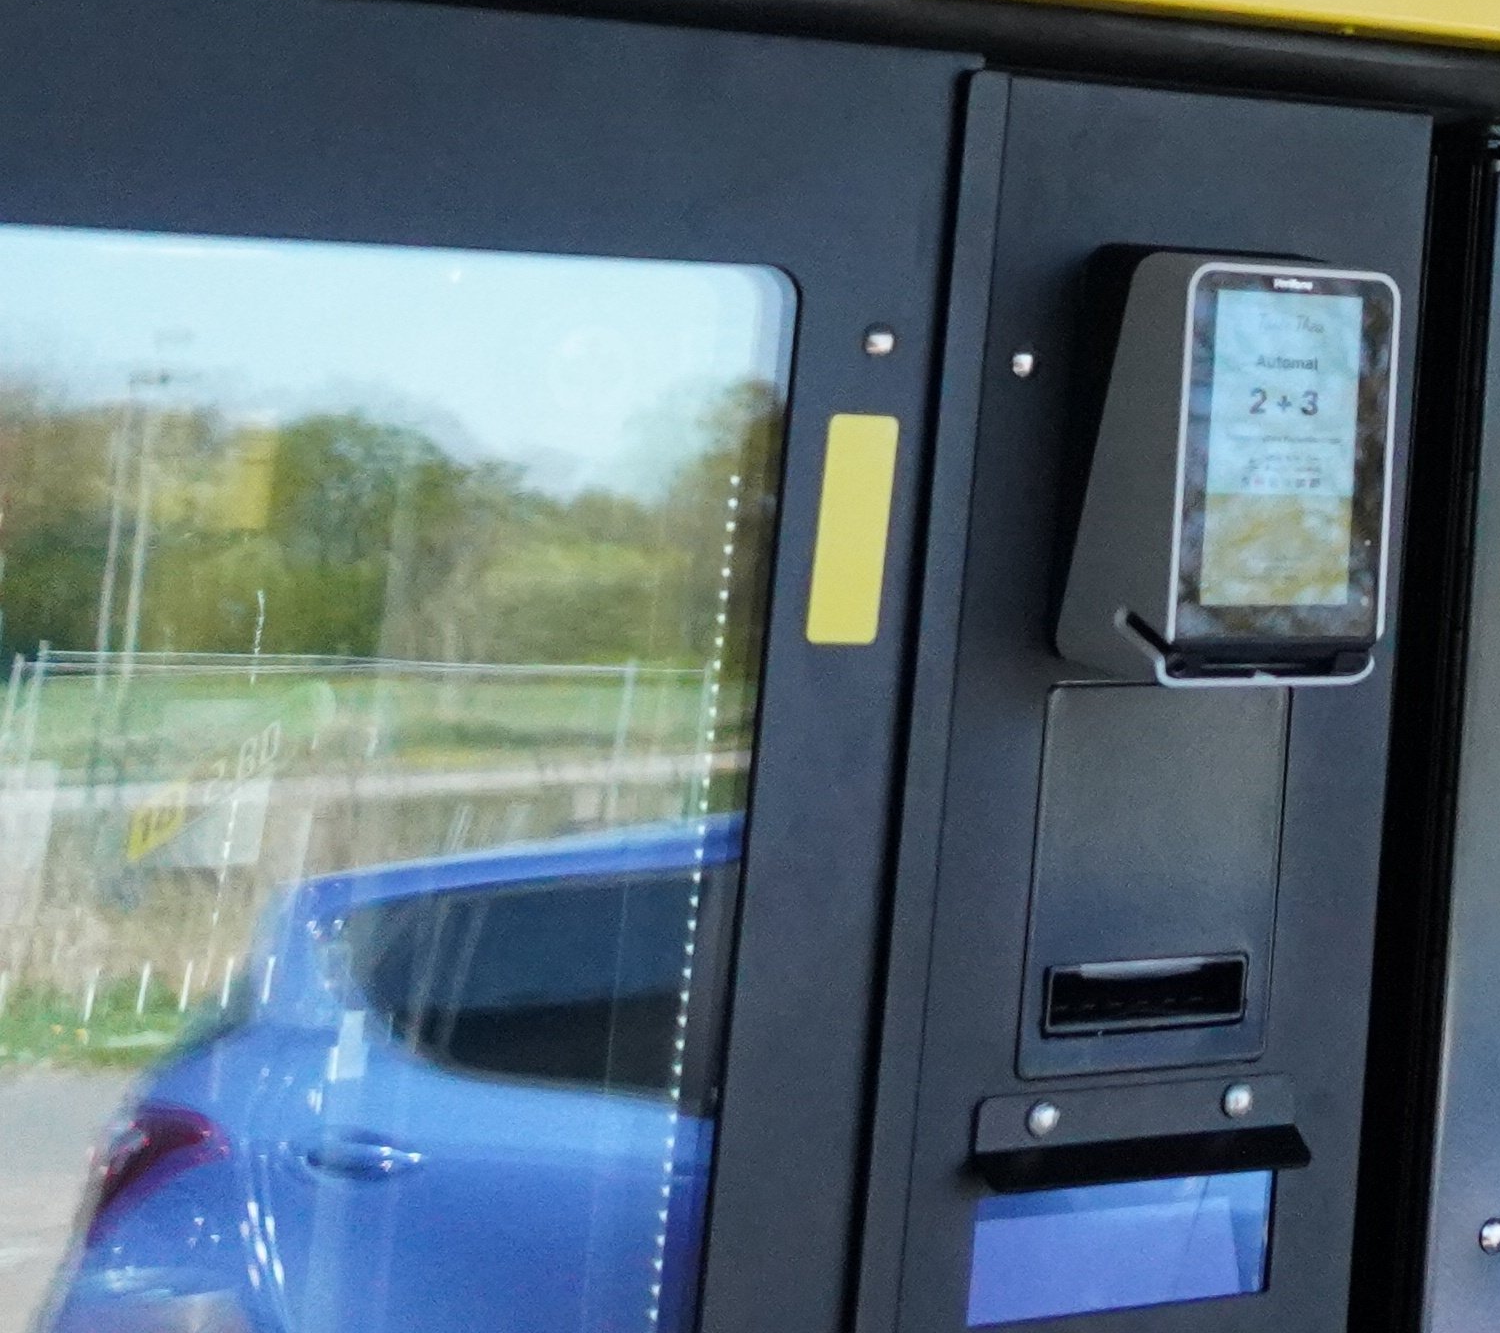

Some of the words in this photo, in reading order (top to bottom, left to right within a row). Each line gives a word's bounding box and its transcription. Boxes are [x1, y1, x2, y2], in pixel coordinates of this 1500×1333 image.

[1256, 353, 1319, 371] Automat
[1249, 387, 1267, 415] 2
[1301, 389, 1319, 416] 3
